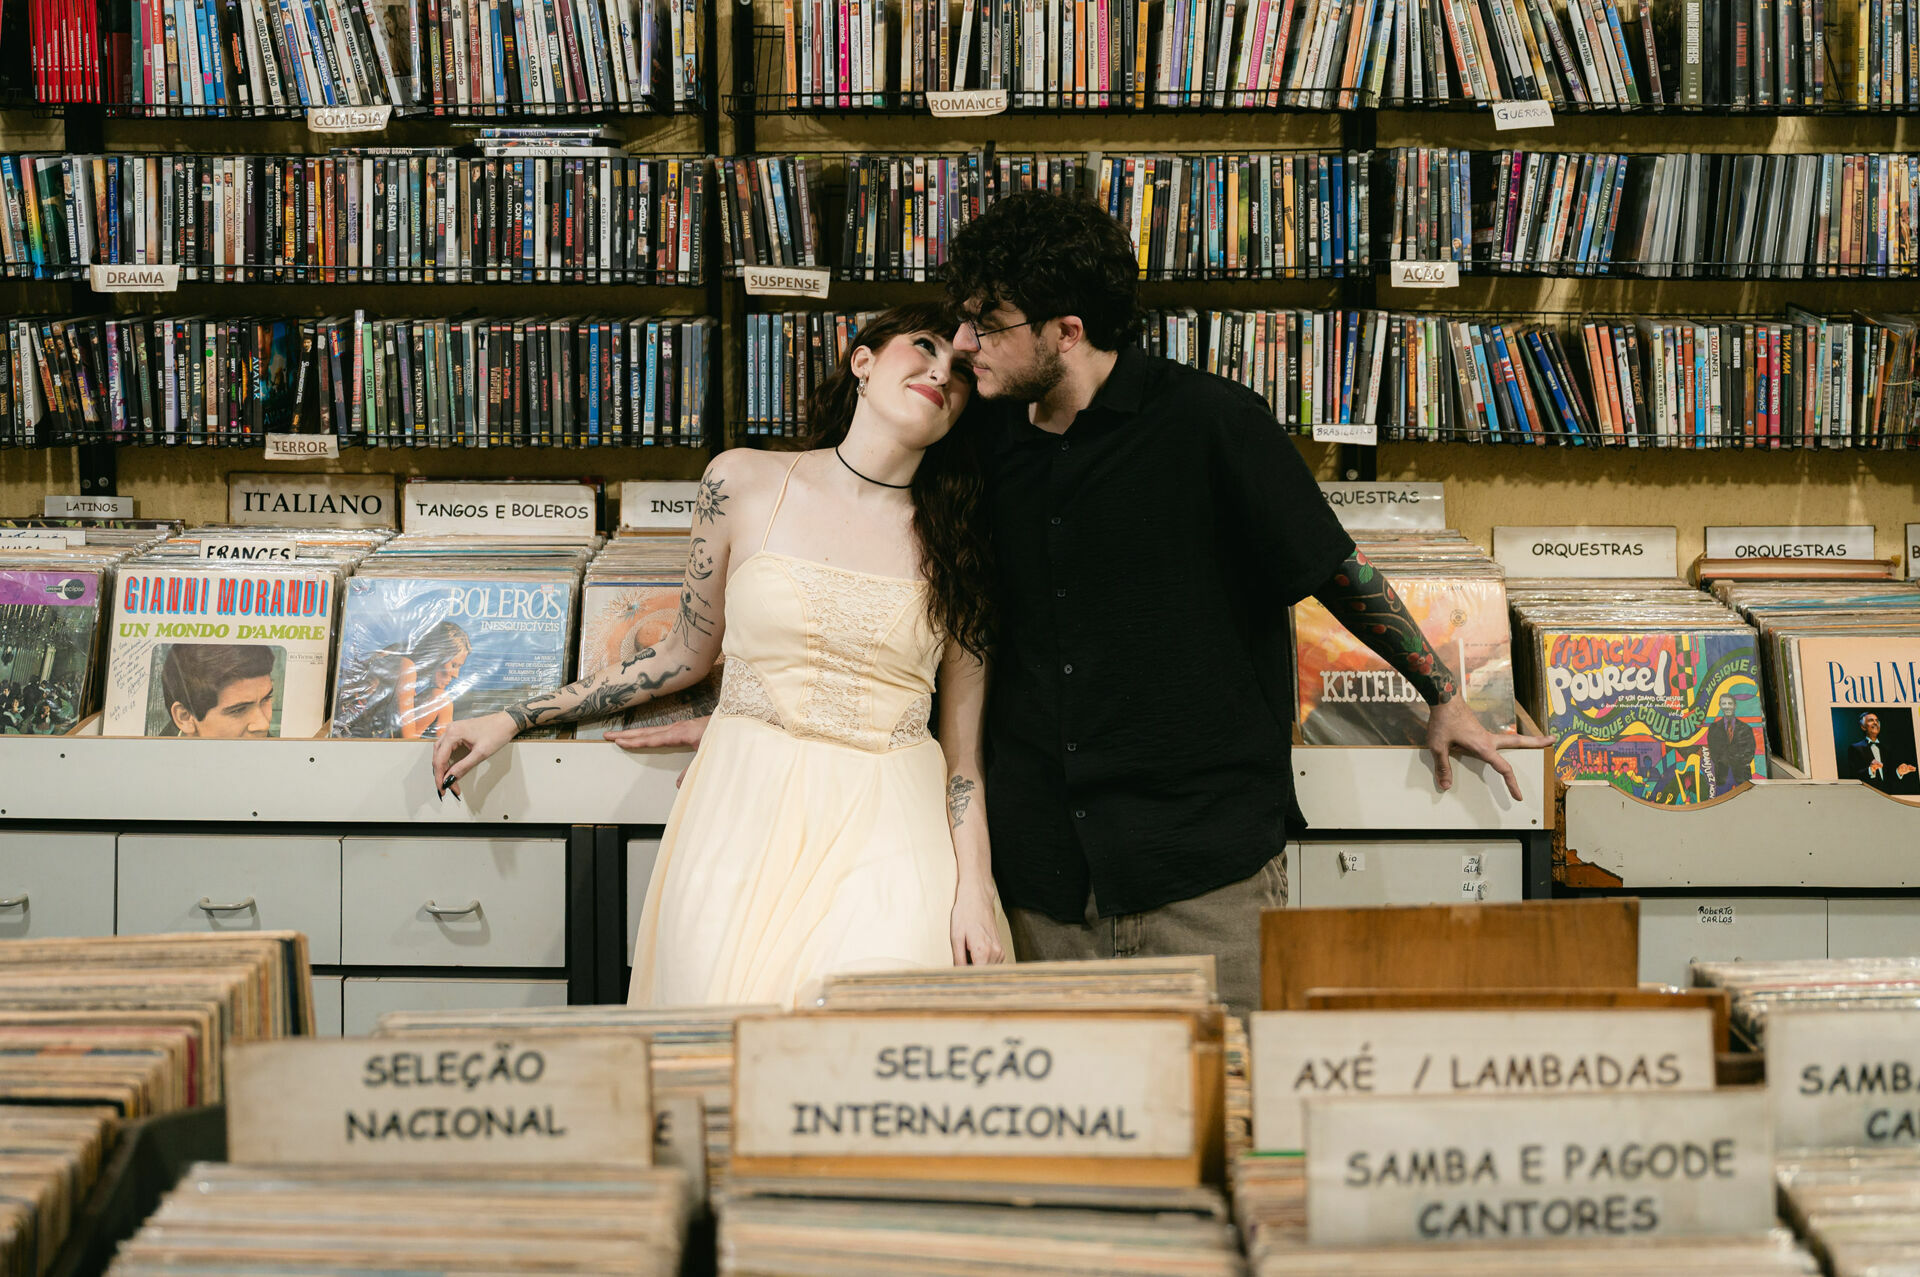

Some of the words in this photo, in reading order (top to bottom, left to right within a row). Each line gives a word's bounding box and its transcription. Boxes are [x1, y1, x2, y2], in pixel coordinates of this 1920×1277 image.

[1688, 3, 1698, 20] BAND
[273, 13, 284, 46] PENETRAS
[319, 20, 327, 36] AMOR
[342, 17, 350, 29] NO
[347, 31, 357, 56] CORRE
[257, 19, 267, 36] QUERO
[262, 38, 270, 53] DIZER
[268, 74, 276, 86] AMO
[323, 38, 332, 51] SEM
[940, 37, 948, 56] Lua
[1687, 29, 1699, 63] BROTHERS
[327, 52, 338, 78] ESCALAS
[456, 51, 465, 85] aloprado
[530, 56, 538, 87] CASADO
[940, 57, 945, 66] de
[931, 97, 1002, 110] ROMANCE
[1497, 107, 1548, 120] GUERRA
[314, 110, 382, 126] COMÉDIA
[388, 184, 396, 203] SEM
[668, 202, 676, 228] julieta
[1598, 190, 1610, 228] REGRESSO
[68, 220, 77, 258] FRONTEIRAS
[107, 272, 164, 284] DRAMA
[750, 275, 820, 289] SUSPENSE
[1404, 266, 1444, 282] AÇÃO
[774, 363, 779, 373] DE
[273, 441, 328, 452] TERROR
[66, 502, 118, 513] LATINOS
[243, 490, 382, 515] ITALIANO
[416, 502, 488, 518] TANGOS
[496, 504, 505, 519] E
[512, 503, 589, 520] BOLEROS
[1532, 543, 1644, 558] ORQUESTRAS
[1735, 544, 1846, 559] ORQUESTRAS
[124, 576, 210, 616] GIANNI
[217, 579, 328, 618] MORANDI
[449, 588, 562, 620] BOLEROS
[120, 623, 149, 638] UN
[156, 624, 230, 638] MONDO
[236, 624, 326, 641] D'AMORE
[480, 620, 560, 632] INESQUECÍVEIS
[1320, 671, 1425, 702] KETELB
[1826, 662, 1886, 703] Paul
[1889, 662, 1920, 703] M
[1625, 710, 1636, 725] et
[1702, 746, 1714, 781] ARANJUEZ
[1702, 916, 1732, 924] CARLOS
[363, 1044, 546, 1090] SELEÇÃO
[875, 1037, 1052, 1086] SELEÇÃO
[1294, 1042, 1376, 1092] AXÉ
[1451, 1054, 1682, 1089] LAMBADAS
[345, 1104, 567, 1141] NACIONAL
[792, 1102, 1137, 1140] INTERNACIONAL
[1344, 1149, 1499, 1187] SAMBA
[1520, 1146, 1544, 1184] E
[1565, 1139, 1736, 1182] PAGODE
[1418, 1196, 1660, 1240] CANTORES
